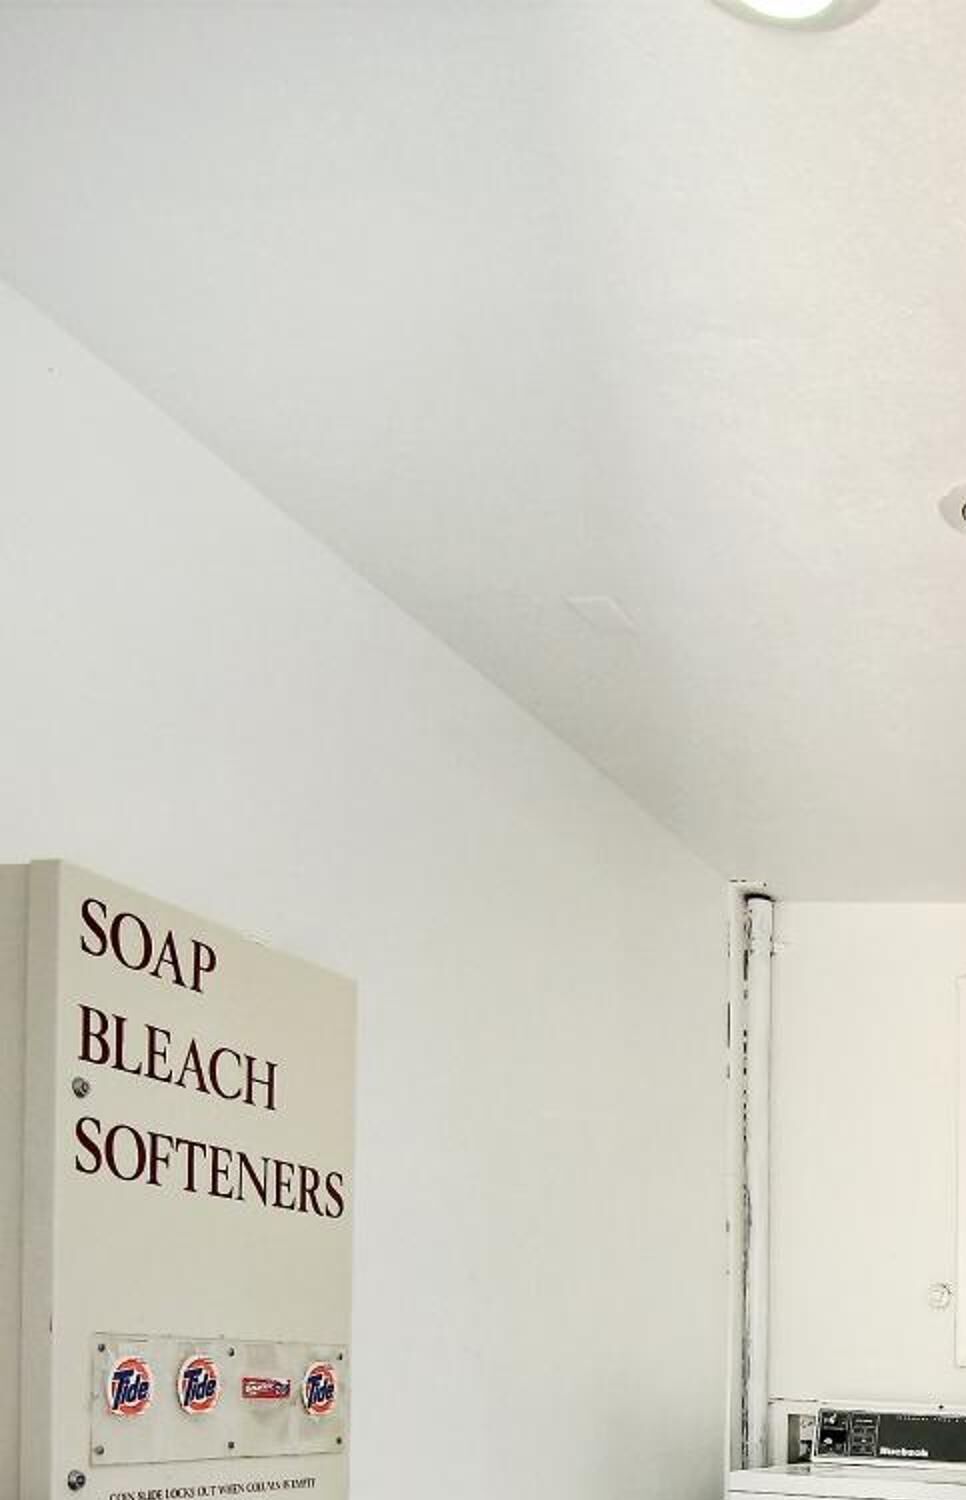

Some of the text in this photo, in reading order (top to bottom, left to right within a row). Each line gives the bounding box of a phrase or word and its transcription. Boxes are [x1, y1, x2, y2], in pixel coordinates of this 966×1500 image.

[80, 897, 218, 993] SOAP
[77, 1003, 279, 1112] BLEACH
[74, 1115, 345, 1219] SOFTENERS
[112, 1369, 150, 1411] Tide
[183, 1367, 217, 1407] Tide
[306, 1374, 334, 1409] Tide
[165, 1486, 195, 1500] LOCKS
[197, 1485, 217, 1498] OUT
[219, 1482, 245, 1496] WHEN
